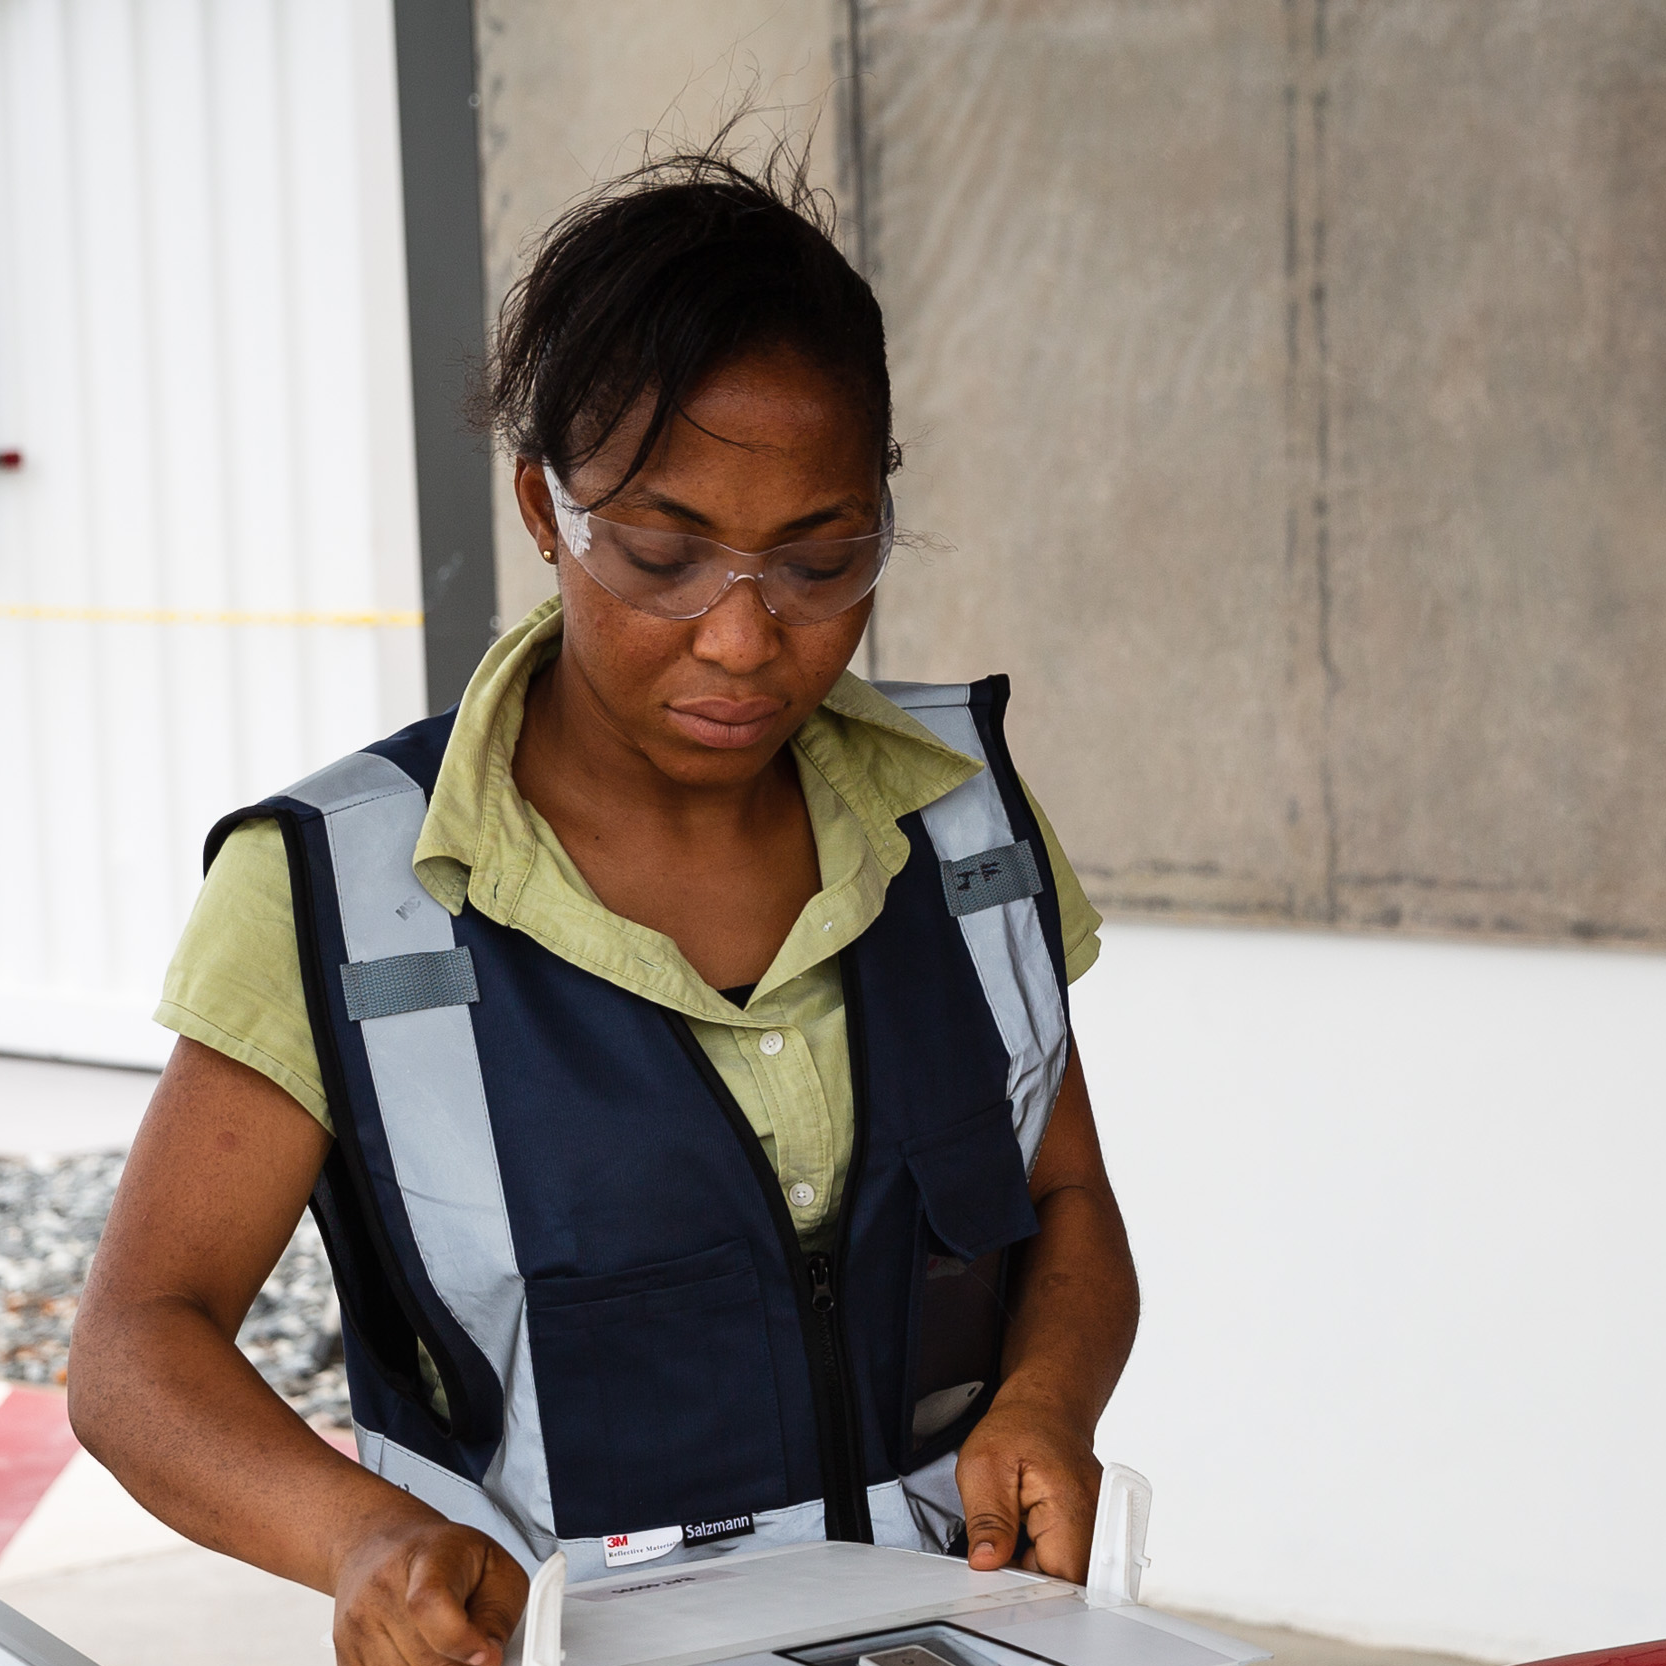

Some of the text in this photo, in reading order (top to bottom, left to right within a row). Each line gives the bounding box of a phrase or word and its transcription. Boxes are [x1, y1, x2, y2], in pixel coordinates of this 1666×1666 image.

[685, 1515, 750, 1539] Salzmann
[607, 1535, 628, 1548] 3M
[608, 1547, 644, 1558] Reflective
